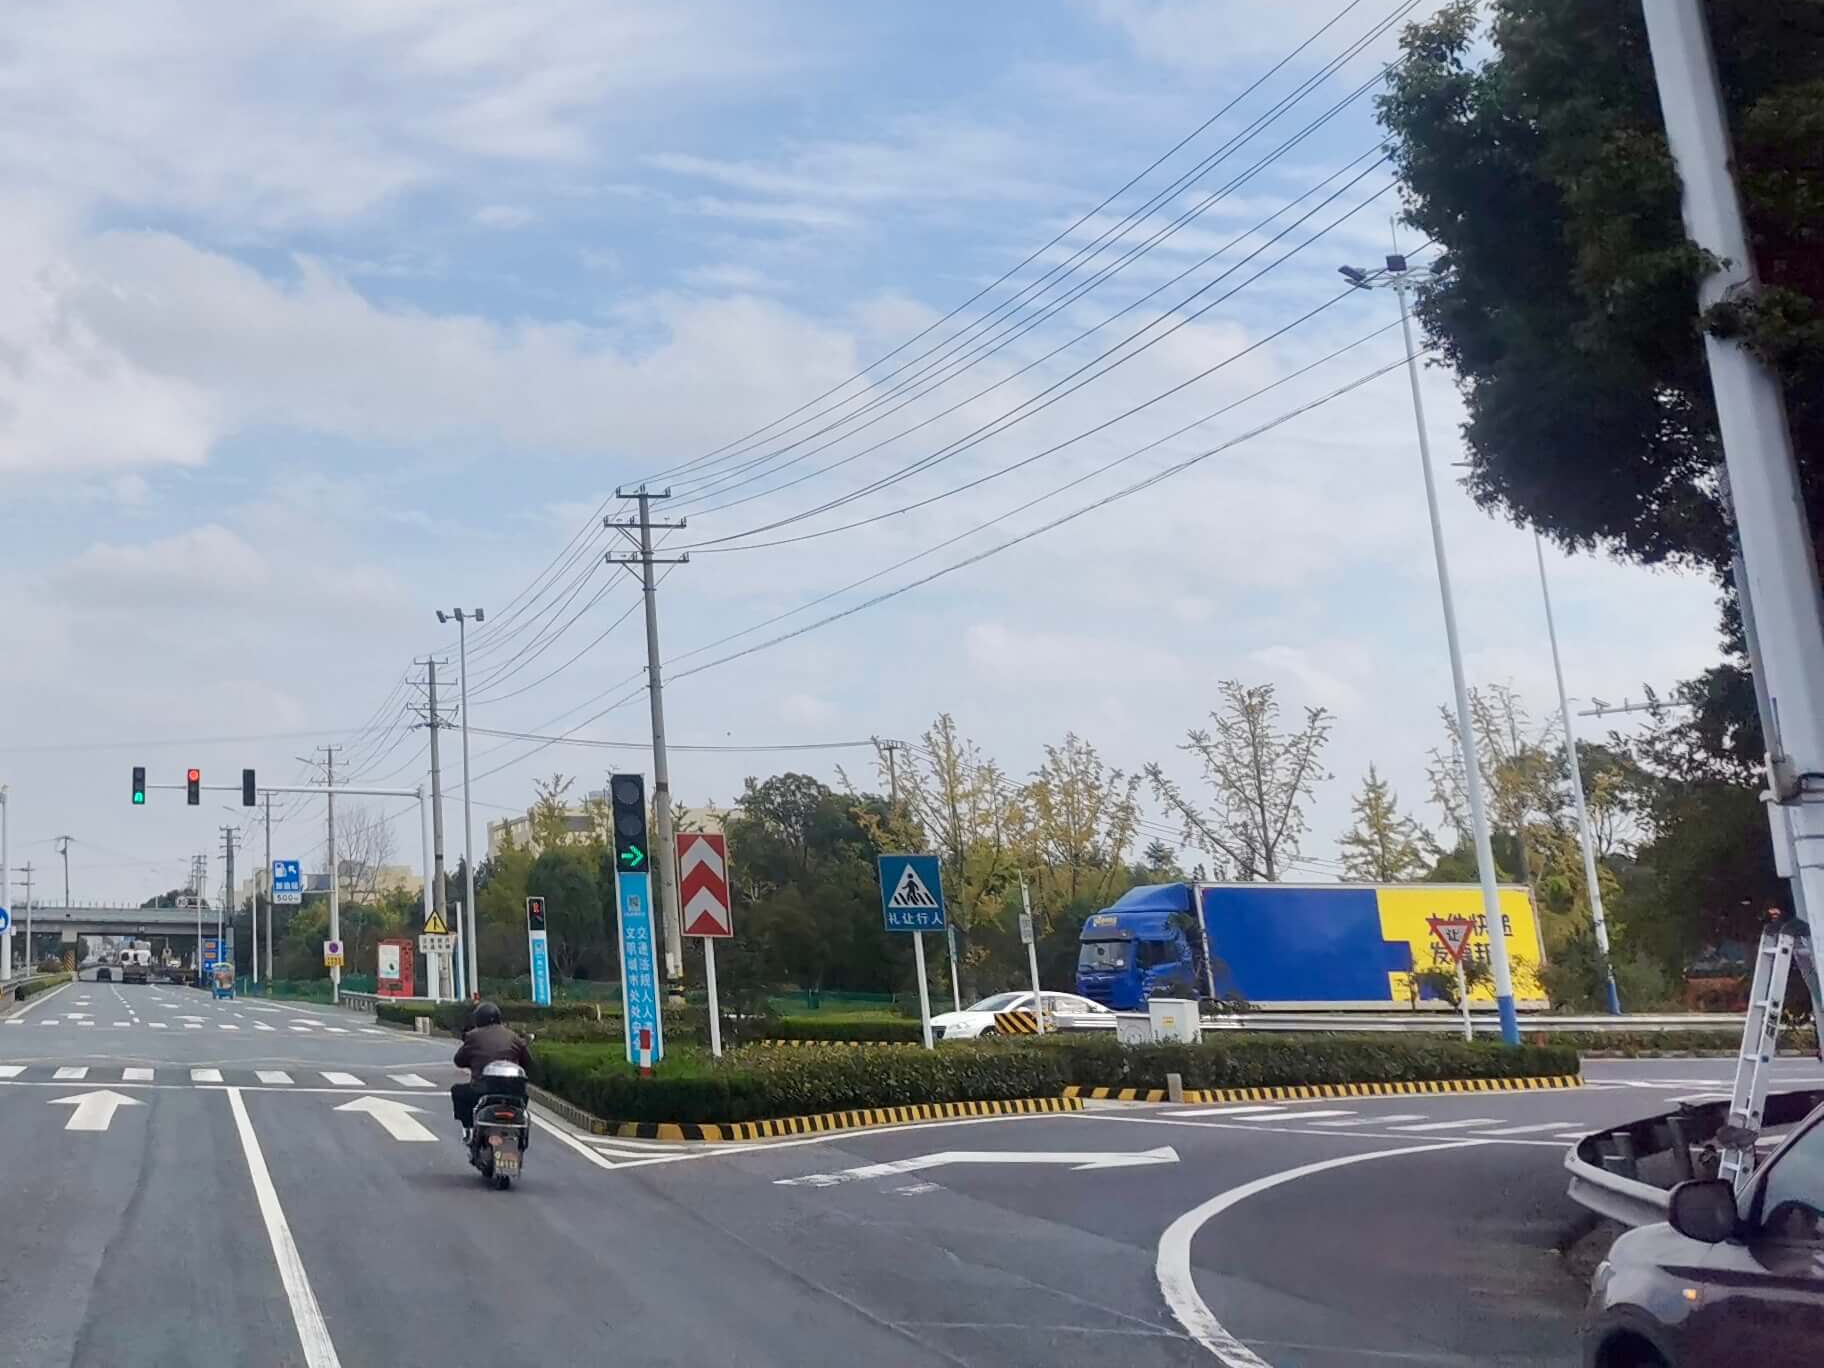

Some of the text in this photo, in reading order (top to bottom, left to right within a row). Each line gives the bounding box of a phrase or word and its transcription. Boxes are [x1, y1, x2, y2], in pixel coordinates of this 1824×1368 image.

[888, 912, 943, 925] 礼让行人
[1446, 928, 1460, 942] 让
[637, 925, 655, 1049] 交通法规人人
